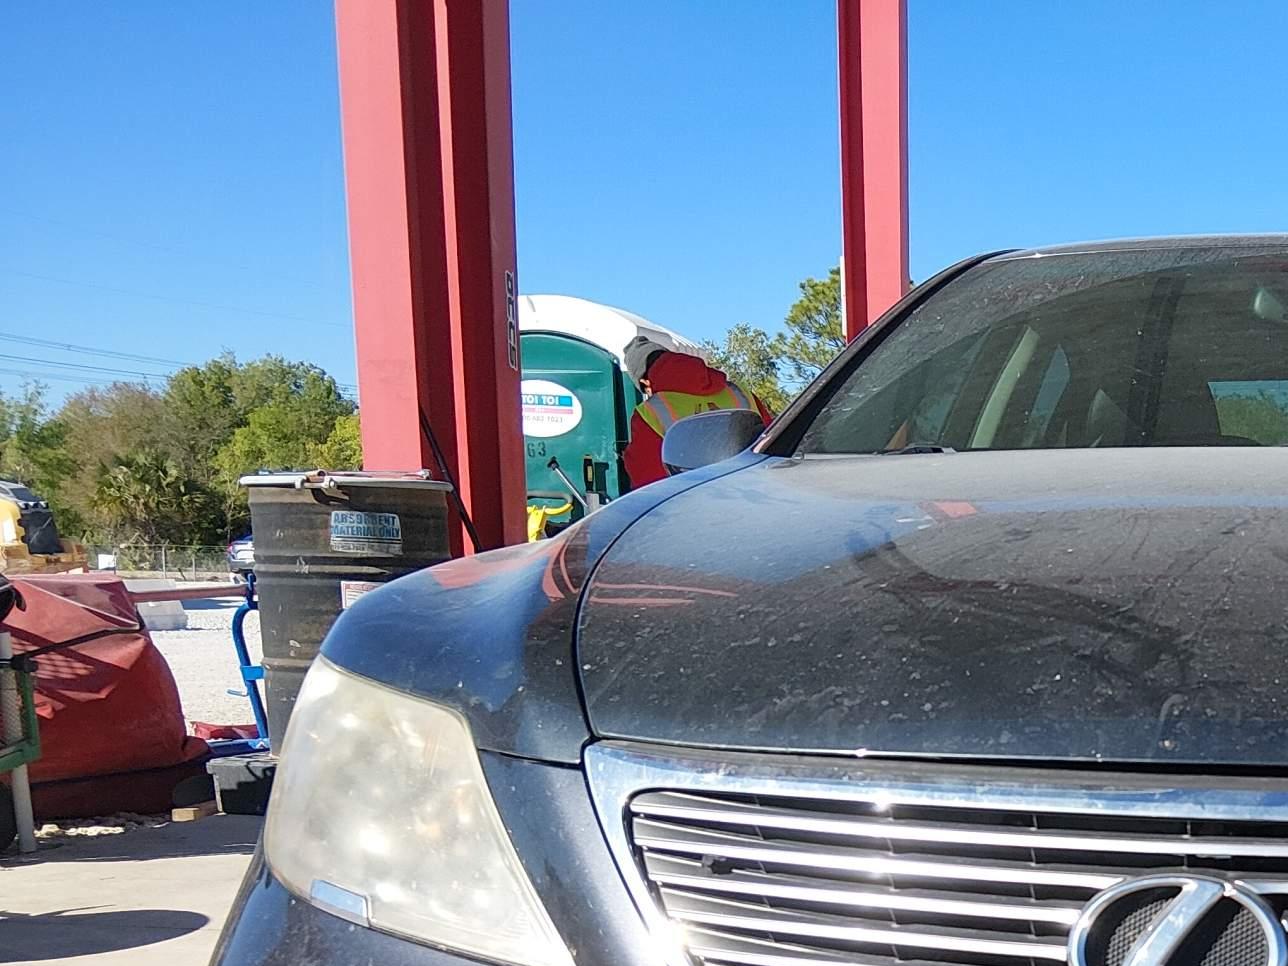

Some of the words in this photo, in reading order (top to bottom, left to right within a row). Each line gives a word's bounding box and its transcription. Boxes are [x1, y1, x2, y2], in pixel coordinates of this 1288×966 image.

[541, 396, 559, 406] TOI
[332, 525, 377, 537] MATERIAL
[378, 526, 400, 538] ONLY
